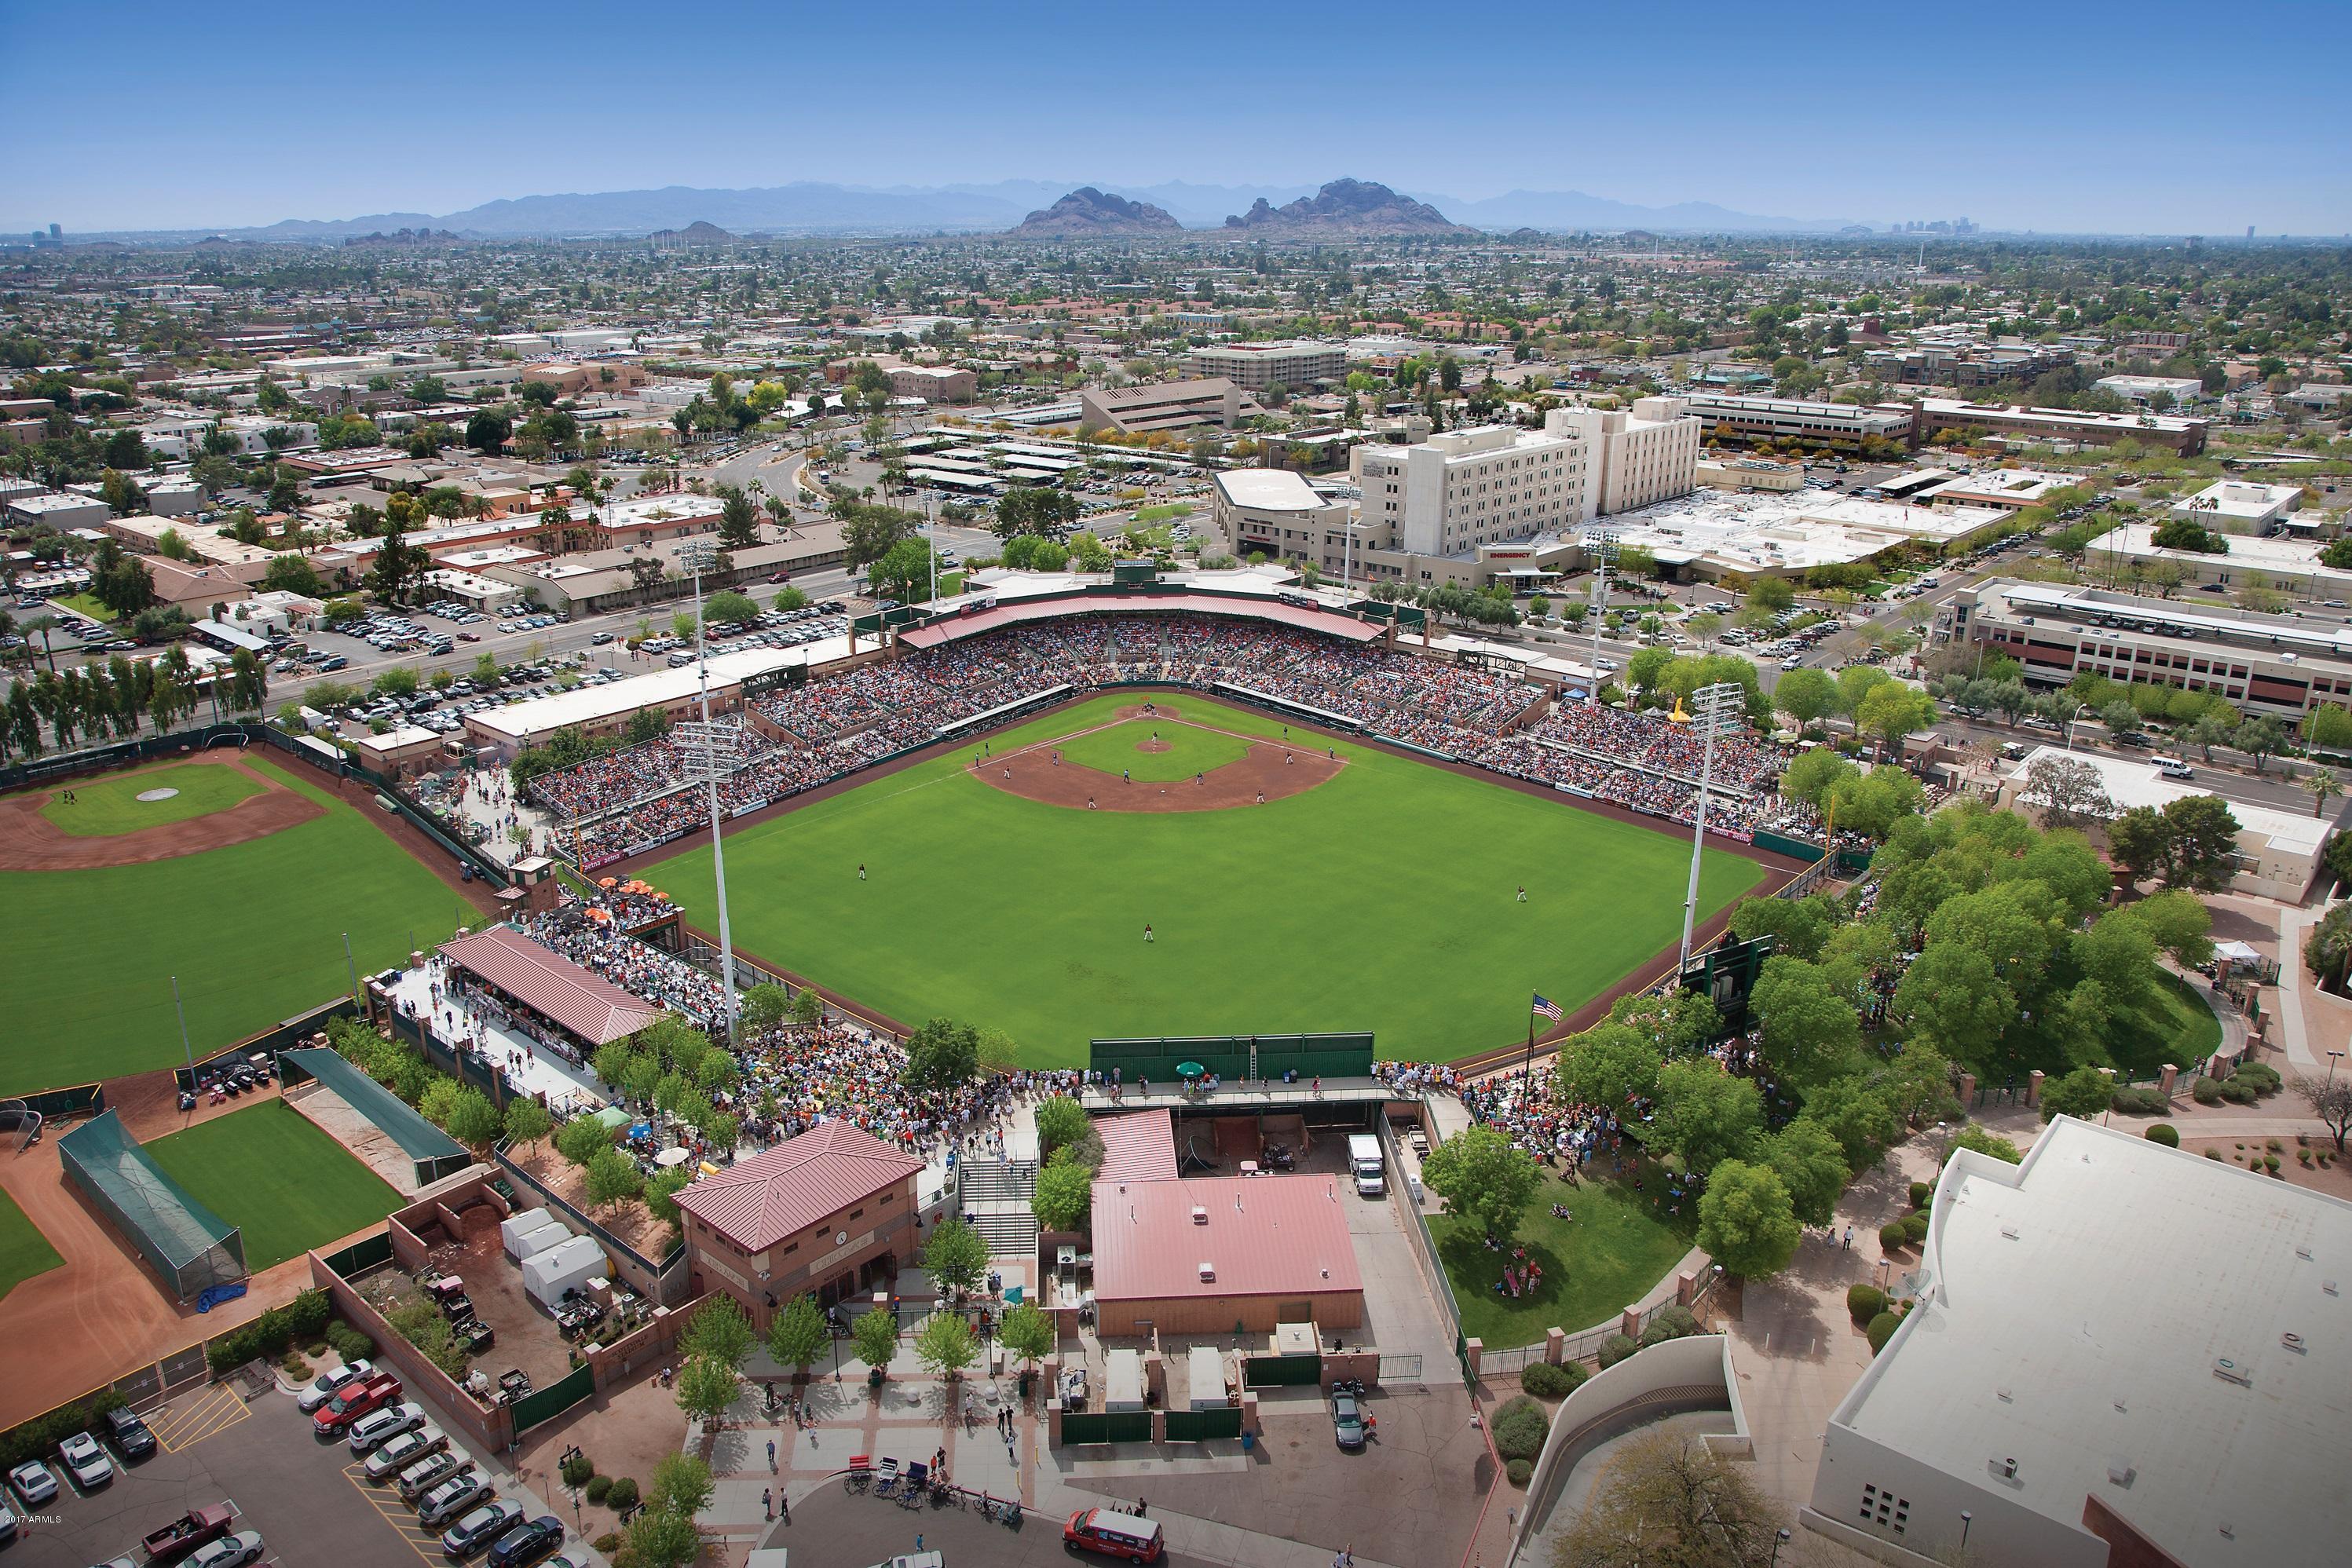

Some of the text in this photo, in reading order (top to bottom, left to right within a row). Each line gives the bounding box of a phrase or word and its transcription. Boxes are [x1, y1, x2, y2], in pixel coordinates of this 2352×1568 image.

[1712, 828, 1750, 842] aetna aetna
[584, 853, 620, 870] aetna aetna
